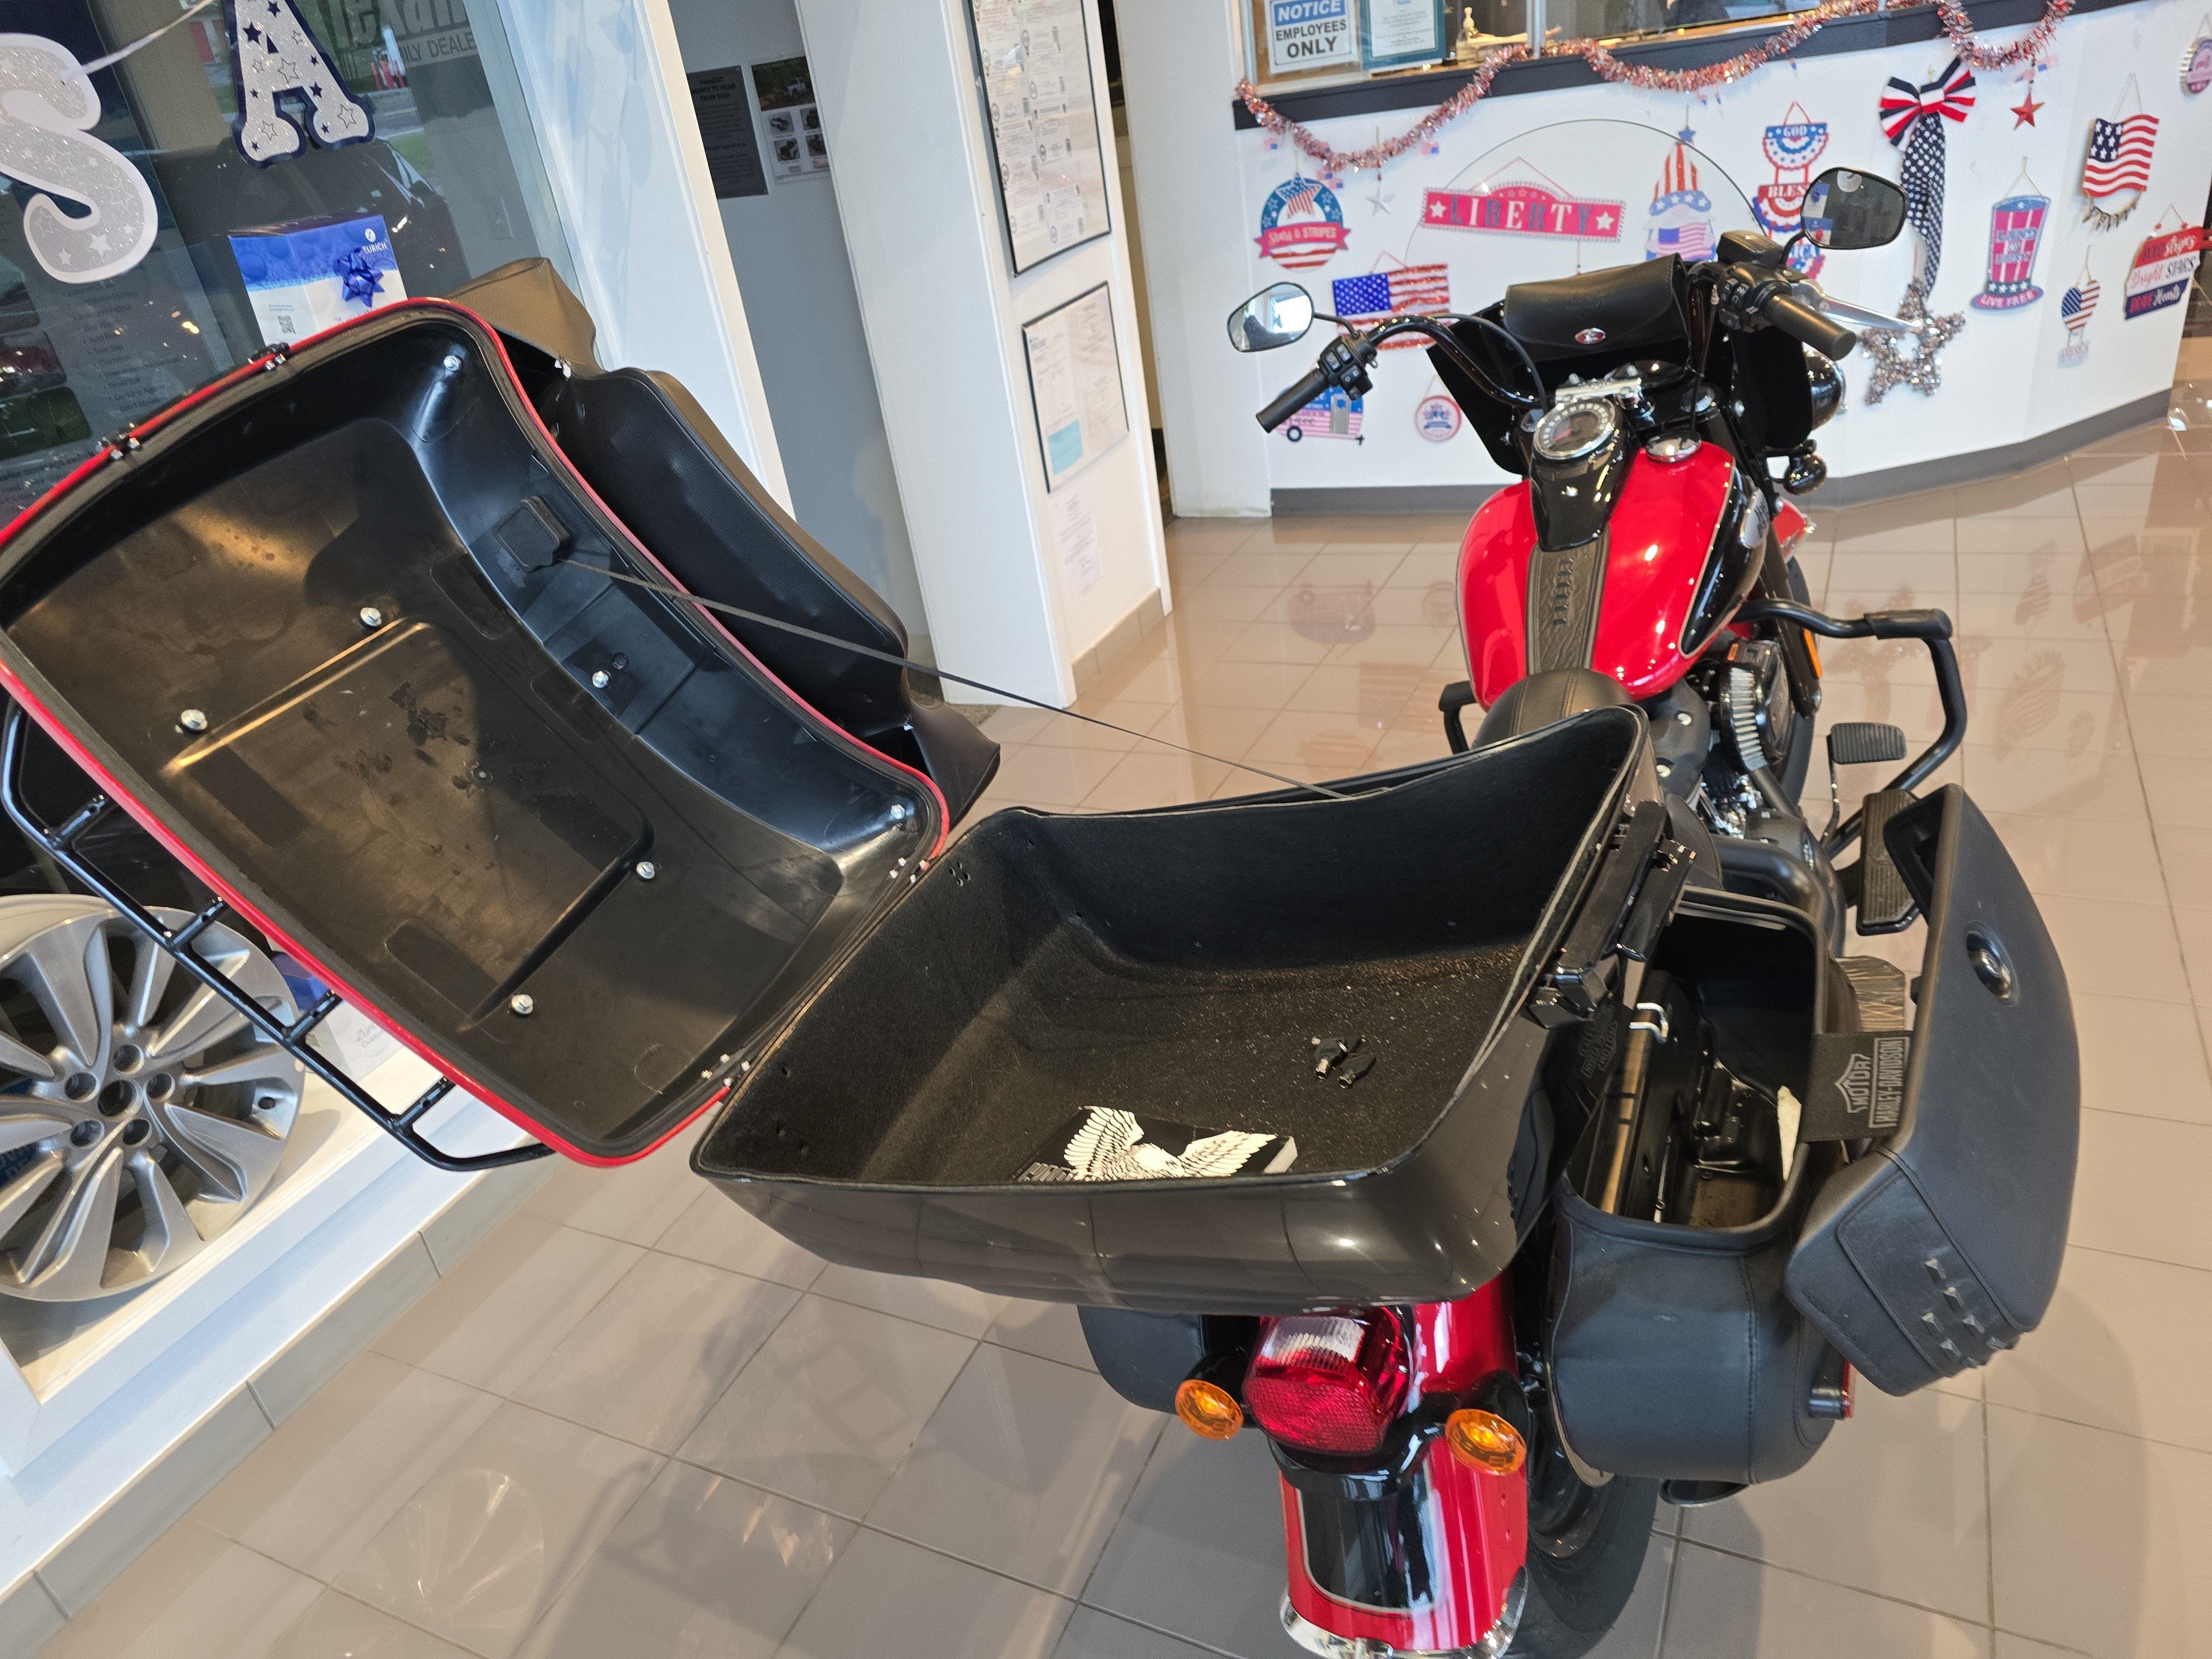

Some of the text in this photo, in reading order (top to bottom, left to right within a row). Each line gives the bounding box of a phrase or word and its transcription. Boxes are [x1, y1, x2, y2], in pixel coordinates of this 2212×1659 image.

[1278, 0, 1341, 22] NOTICE
[1276, 19, 1347, 41] EMPLOYEES
[426, 31, 477, 57] DEALE
[1287, 35, 1338, 58] ONLY
[1783, 125, 1808, 137] GOD
[1768, 185, 1806, 197] BLES
[1450, 196, 1593, 234] LIBERTY
[1980, 289, 2034, 307] LIVE FREE
[1843, 1060, 1870, 1106] MOTOR
